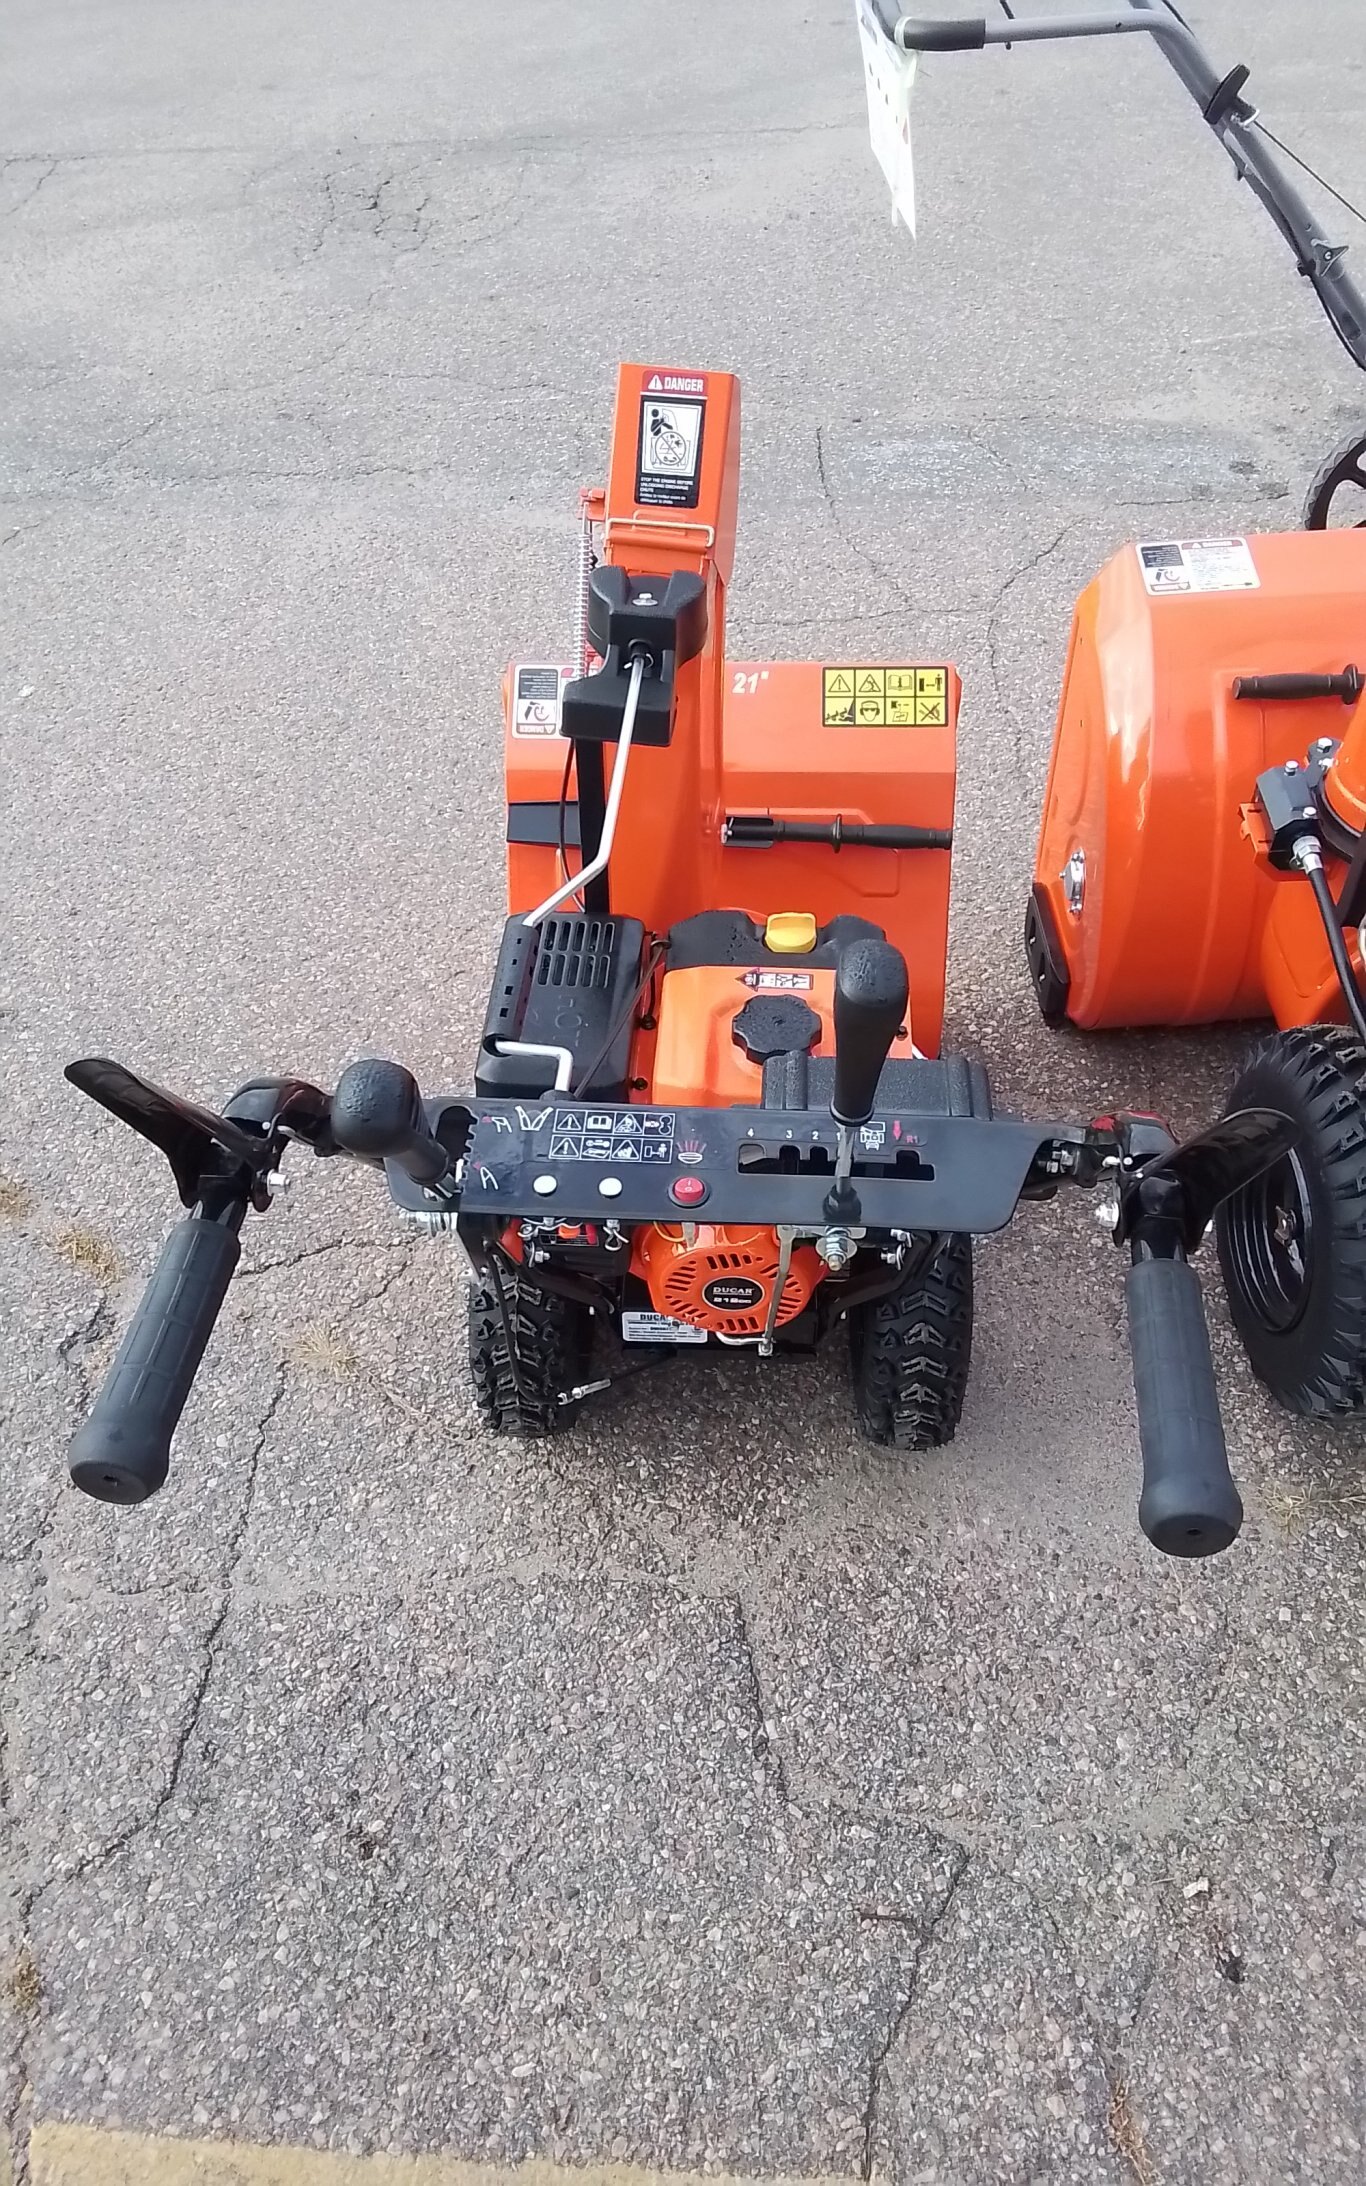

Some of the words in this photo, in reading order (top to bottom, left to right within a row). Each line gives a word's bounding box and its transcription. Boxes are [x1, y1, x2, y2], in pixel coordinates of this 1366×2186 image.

[664, 377, 703, 392] DANGER
[732, 670, 769, 694] 21"
[747, 1127, 754, 1138] 4
[785, 1129, 793, 1139] 3
[811, 1130, 819, 1140] 2
[836, 1131, 841, 1141] 1
[905, 1135, 919, 1144] R1
[712, 1286, 753, 1295] DUCAR
